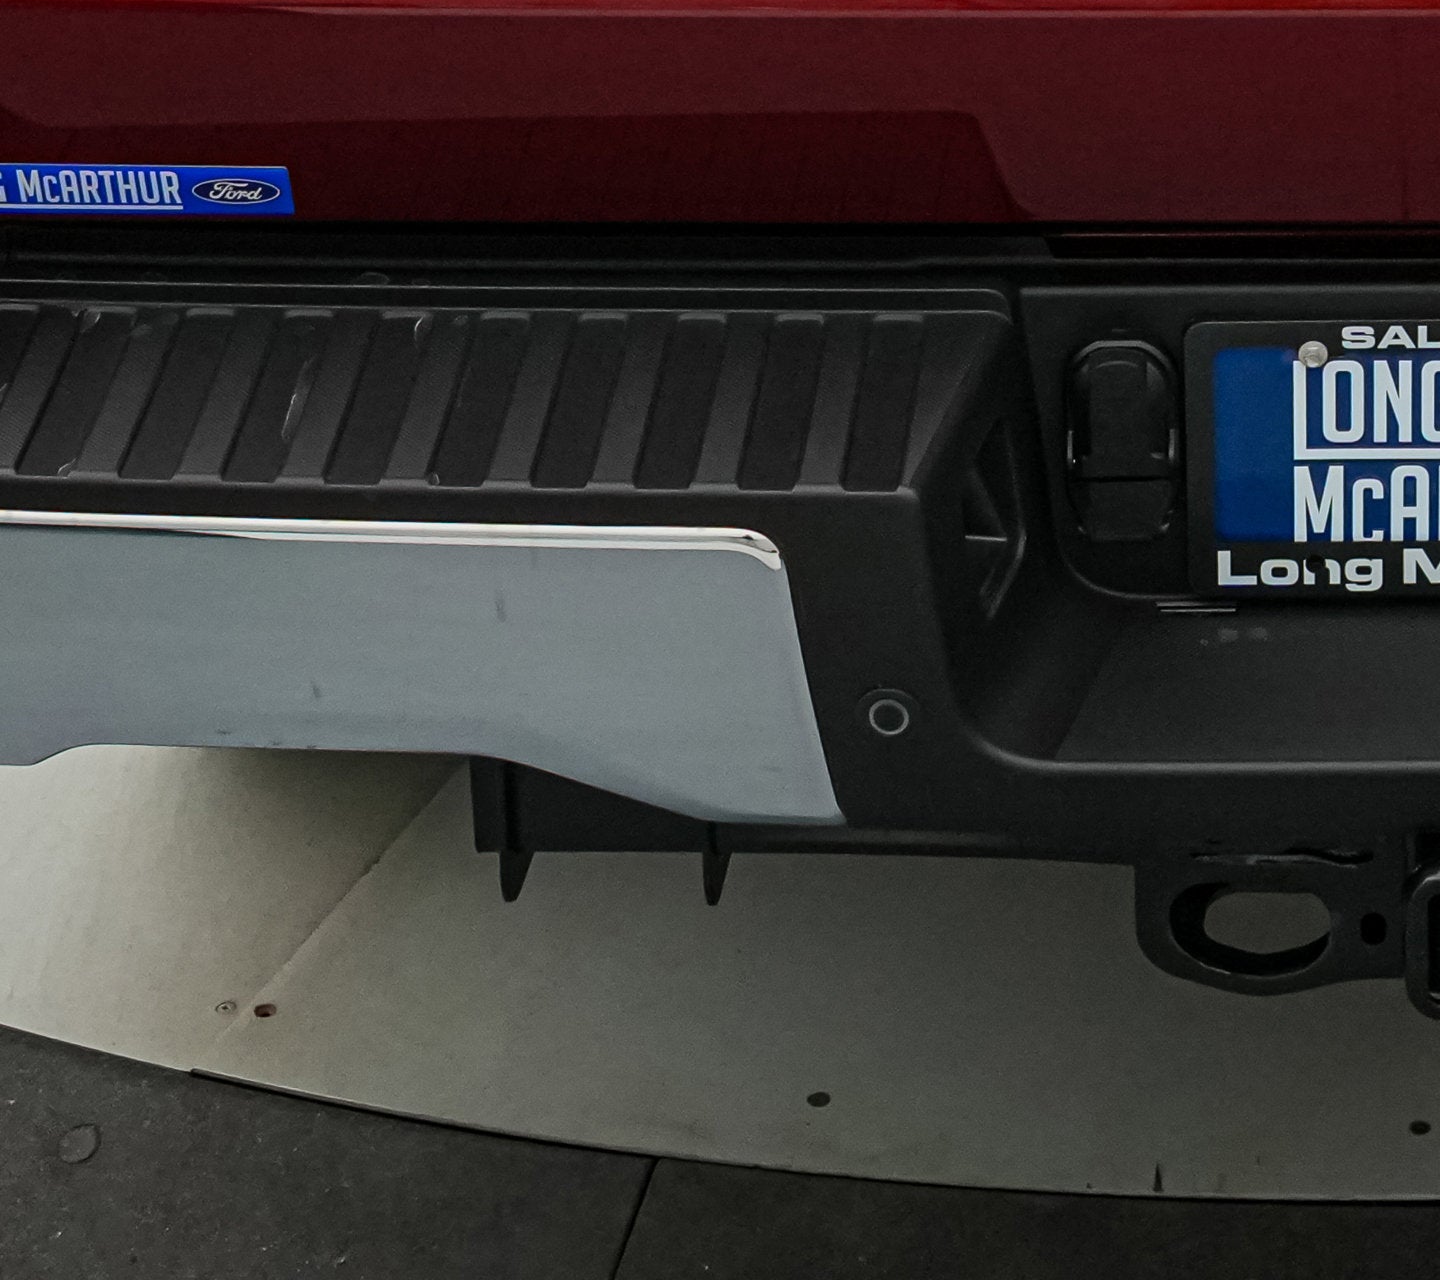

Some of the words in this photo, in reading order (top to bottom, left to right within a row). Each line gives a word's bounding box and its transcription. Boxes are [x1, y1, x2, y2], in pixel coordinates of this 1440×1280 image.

[15, 169, 183, 204] McARTHUR
[208, 182, 264, 202] Ford
[1218, 549, 1386, 593] Long
